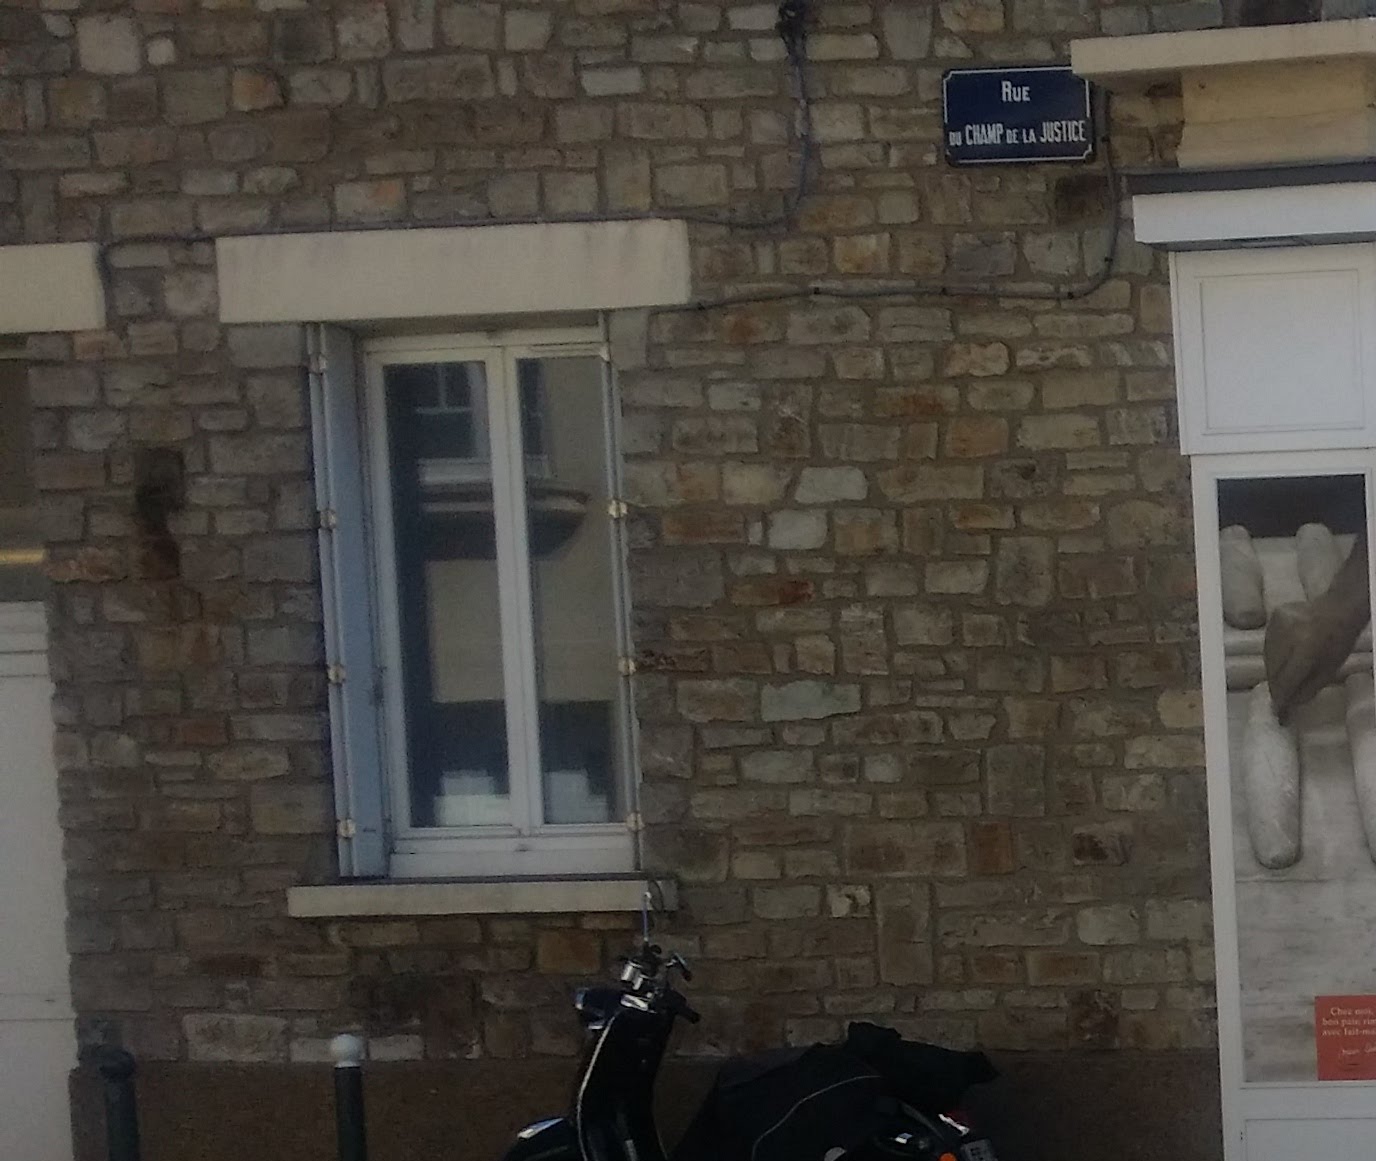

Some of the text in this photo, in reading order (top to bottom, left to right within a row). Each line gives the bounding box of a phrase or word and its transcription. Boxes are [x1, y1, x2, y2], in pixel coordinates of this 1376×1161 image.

[949, 120, 1086, 146] DU CHAMP DE LA JUSTICE
[1330, 1006, 1353, 1016] Chez
[1322, 1018, 1339, 1026] bon
[1341, 1018, 1360, 1027] pain
